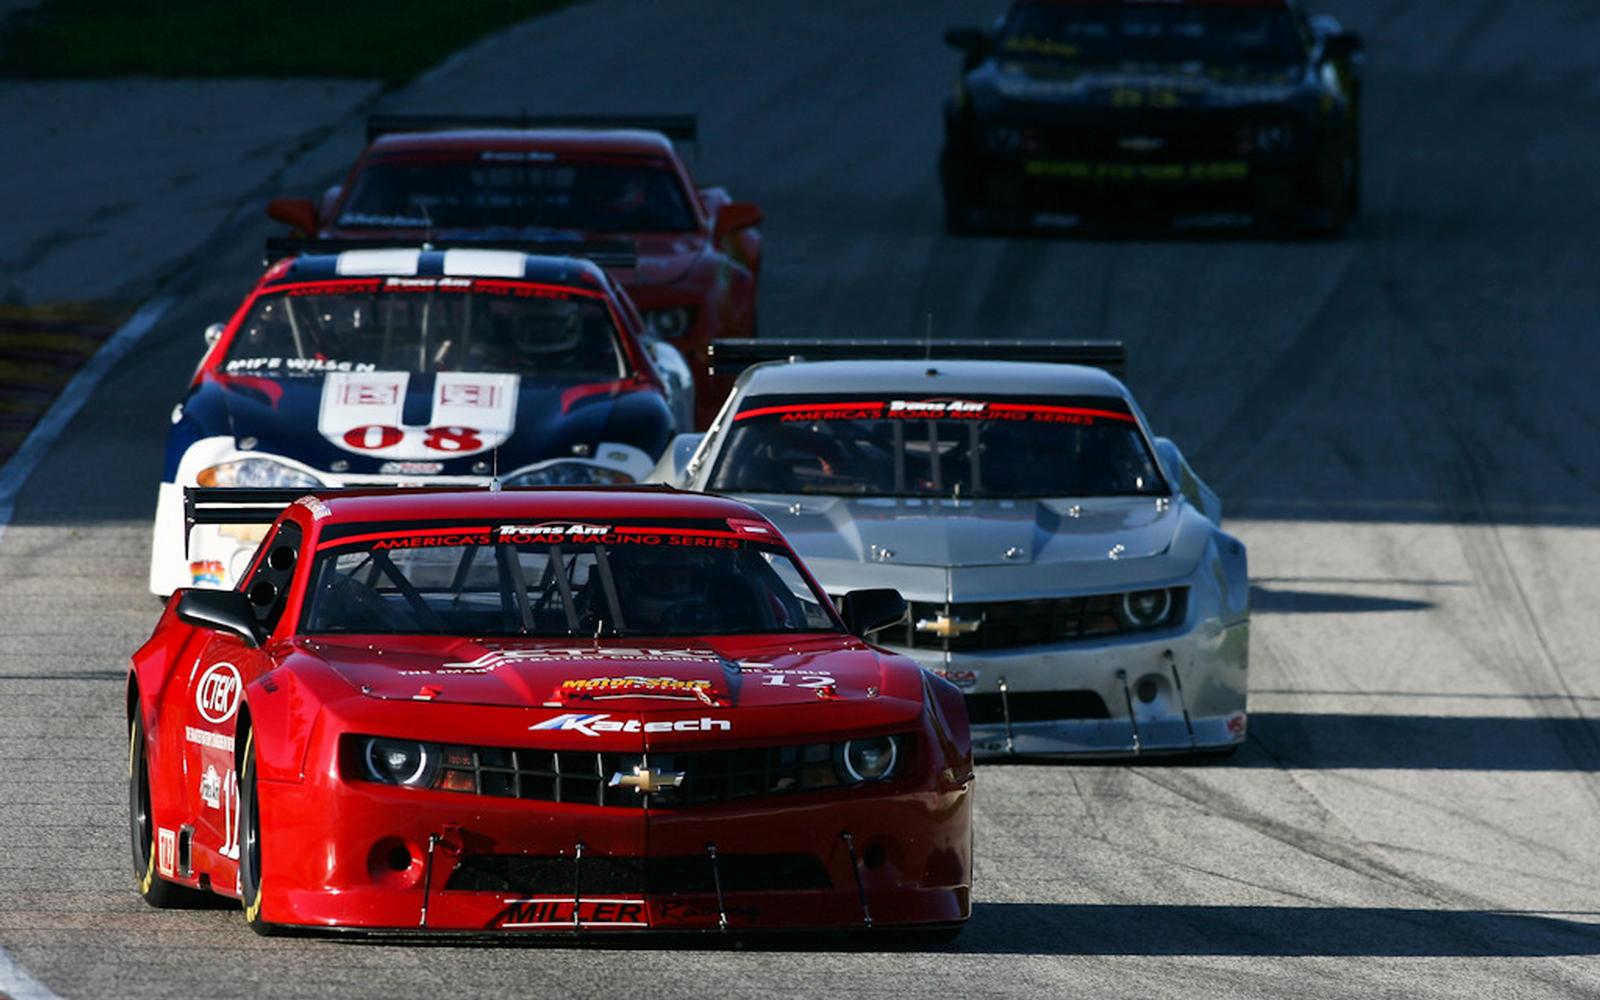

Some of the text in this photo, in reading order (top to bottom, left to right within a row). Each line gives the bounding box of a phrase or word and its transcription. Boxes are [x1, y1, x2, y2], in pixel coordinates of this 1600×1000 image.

[437, 277, 472, 287] Am
[890, 400, 985, 411] Trans Am
[780, 409, 1095, 425] AMERICA'S ROAD RACING SERIES
[343, 425, 483, 452] 08
[499, 525, 609, 535] Trans Am
[371, 534, 740, 551] AMERICA'S ROAD RACING SERIES
[203, 672, 236, 713] CTEK
[529, 713, 732, 737] Katech
[508, 902, 642, 923] MILLER
